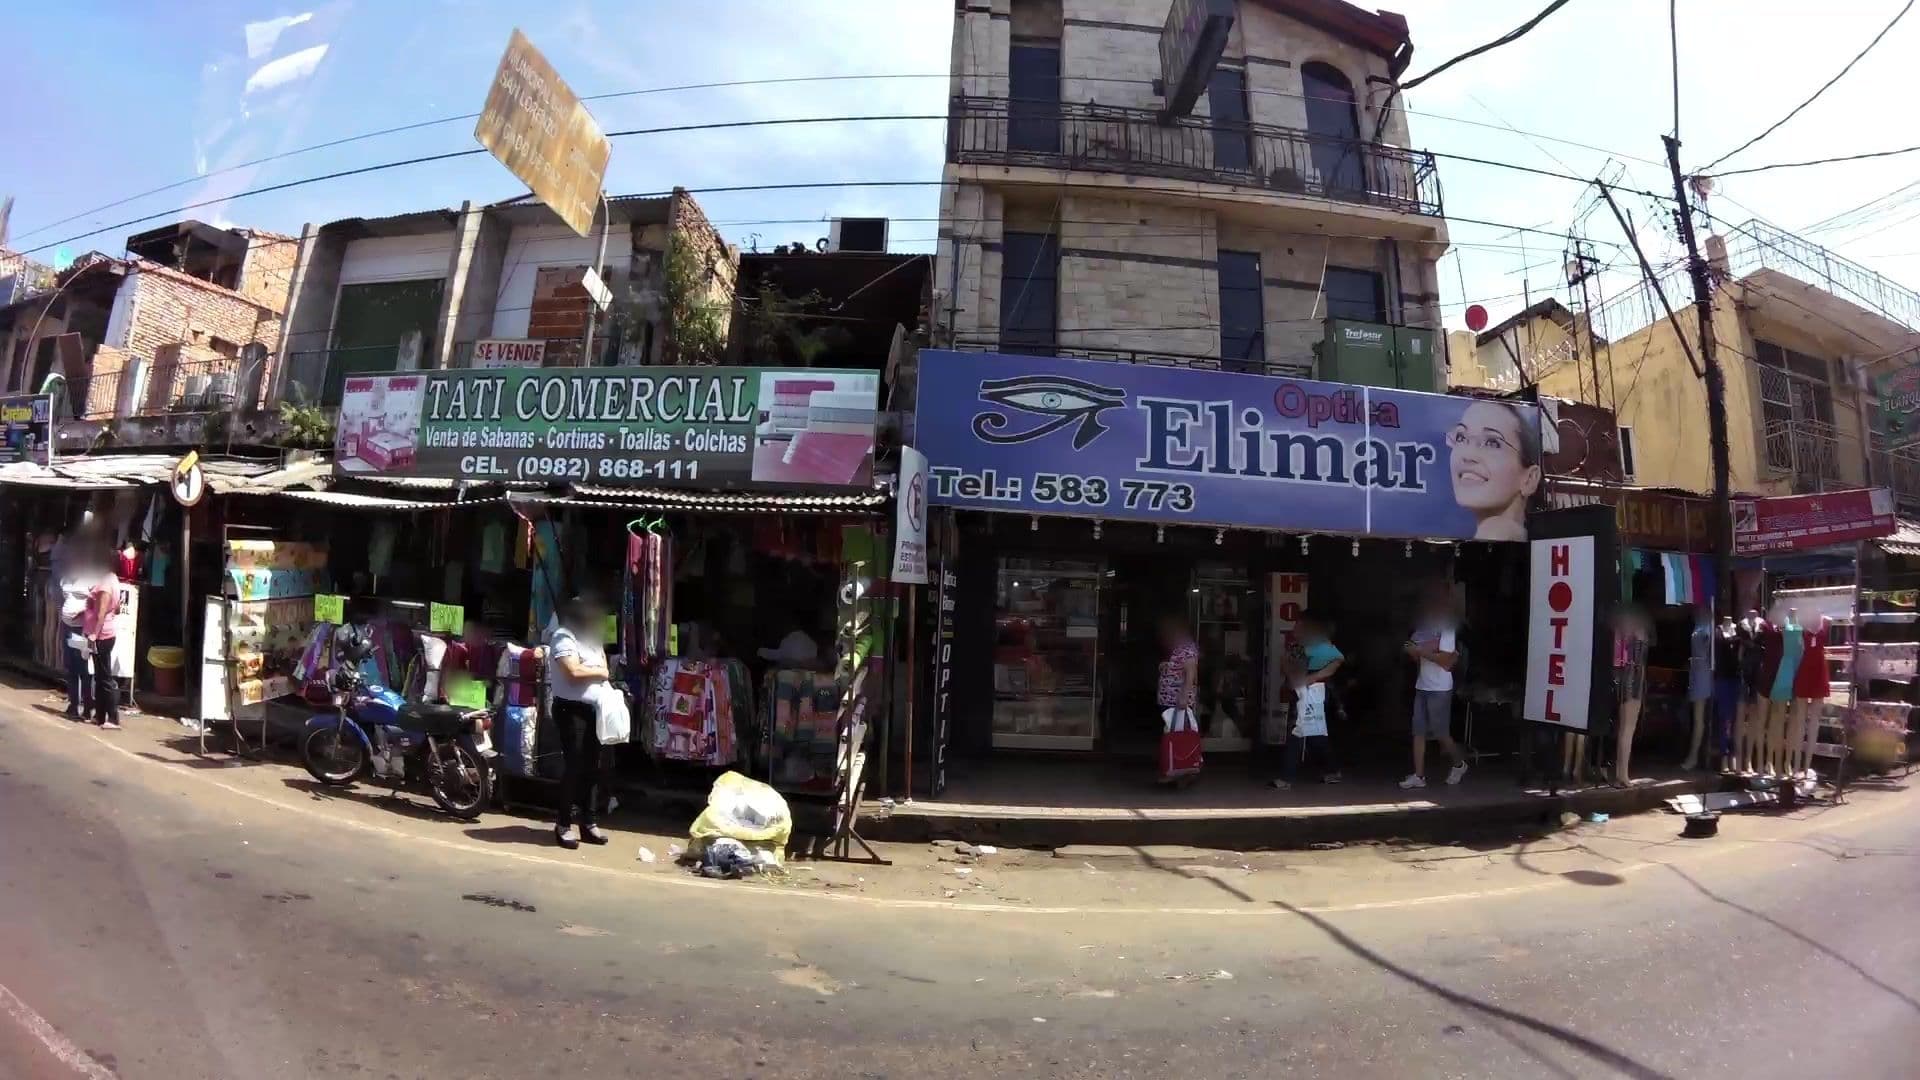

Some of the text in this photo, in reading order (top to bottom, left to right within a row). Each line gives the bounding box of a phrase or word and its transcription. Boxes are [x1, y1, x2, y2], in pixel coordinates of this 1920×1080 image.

[477, 344, 544, 361] SE VENDE
[428, 376, 755, 424] TATI COMERCIAL
[1273, 383, 1400, 428] Optica
[425, 426, 747, 453] Venta de Sabanas Cortinas Toallas Colchas
[1136, 396, 1434, 493] Elimar
[460, 456, 698, 481] CEL. (0982) 868-111
[928, 466, 1195, 512] Tel.: 583 773
[1544, 544, 1573, 722] HOTEL
[936, 644, 951, 795] OPTICA
